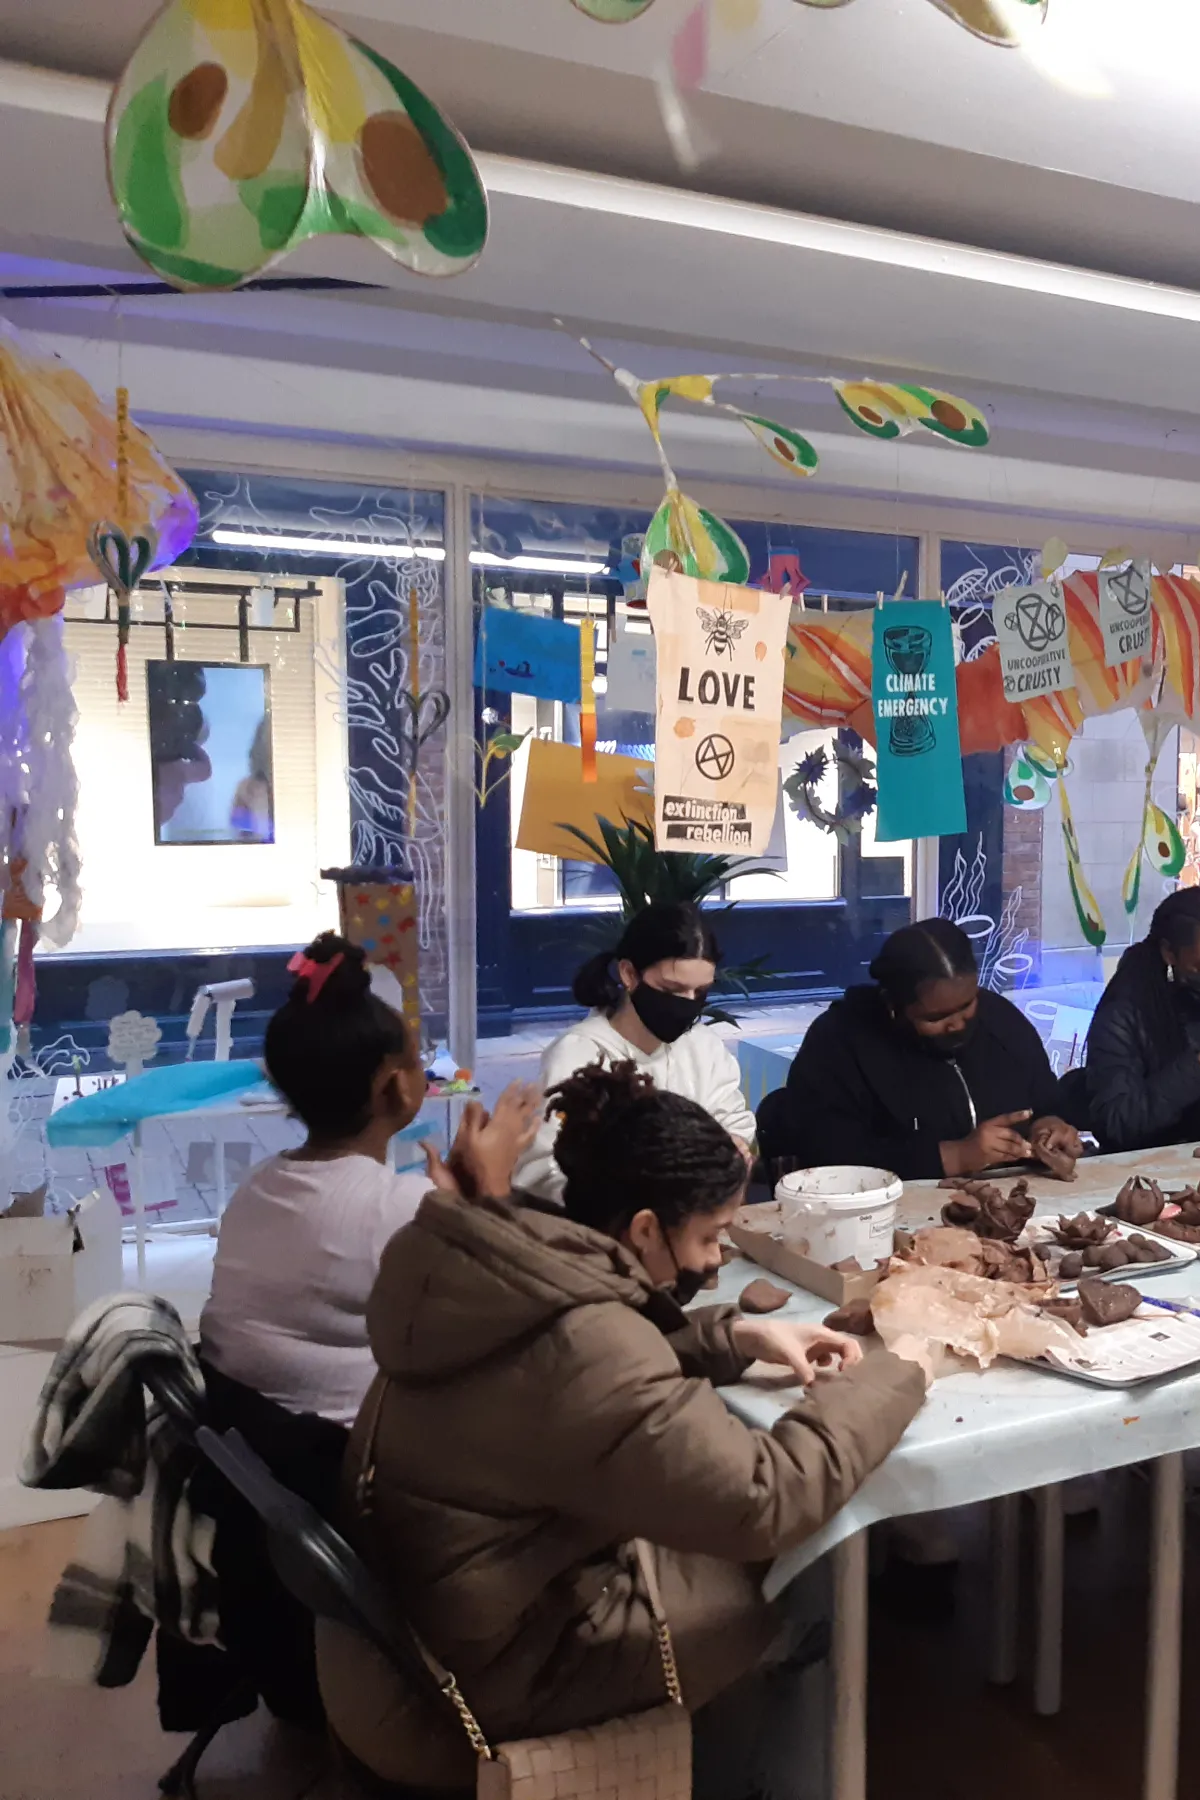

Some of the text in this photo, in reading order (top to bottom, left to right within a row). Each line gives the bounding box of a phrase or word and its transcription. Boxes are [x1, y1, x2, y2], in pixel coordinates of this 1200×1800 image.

[678, 667, 755, 710] LOVE
[886, 673, 936, 692] CLIMATE
[1017, 665, 1060, 692] CRUSTY
[877, 697, 948, 717] EMERGENCY
[664, 800, 738, 821] extinction
[686, 822, 751, 846] rebellion
